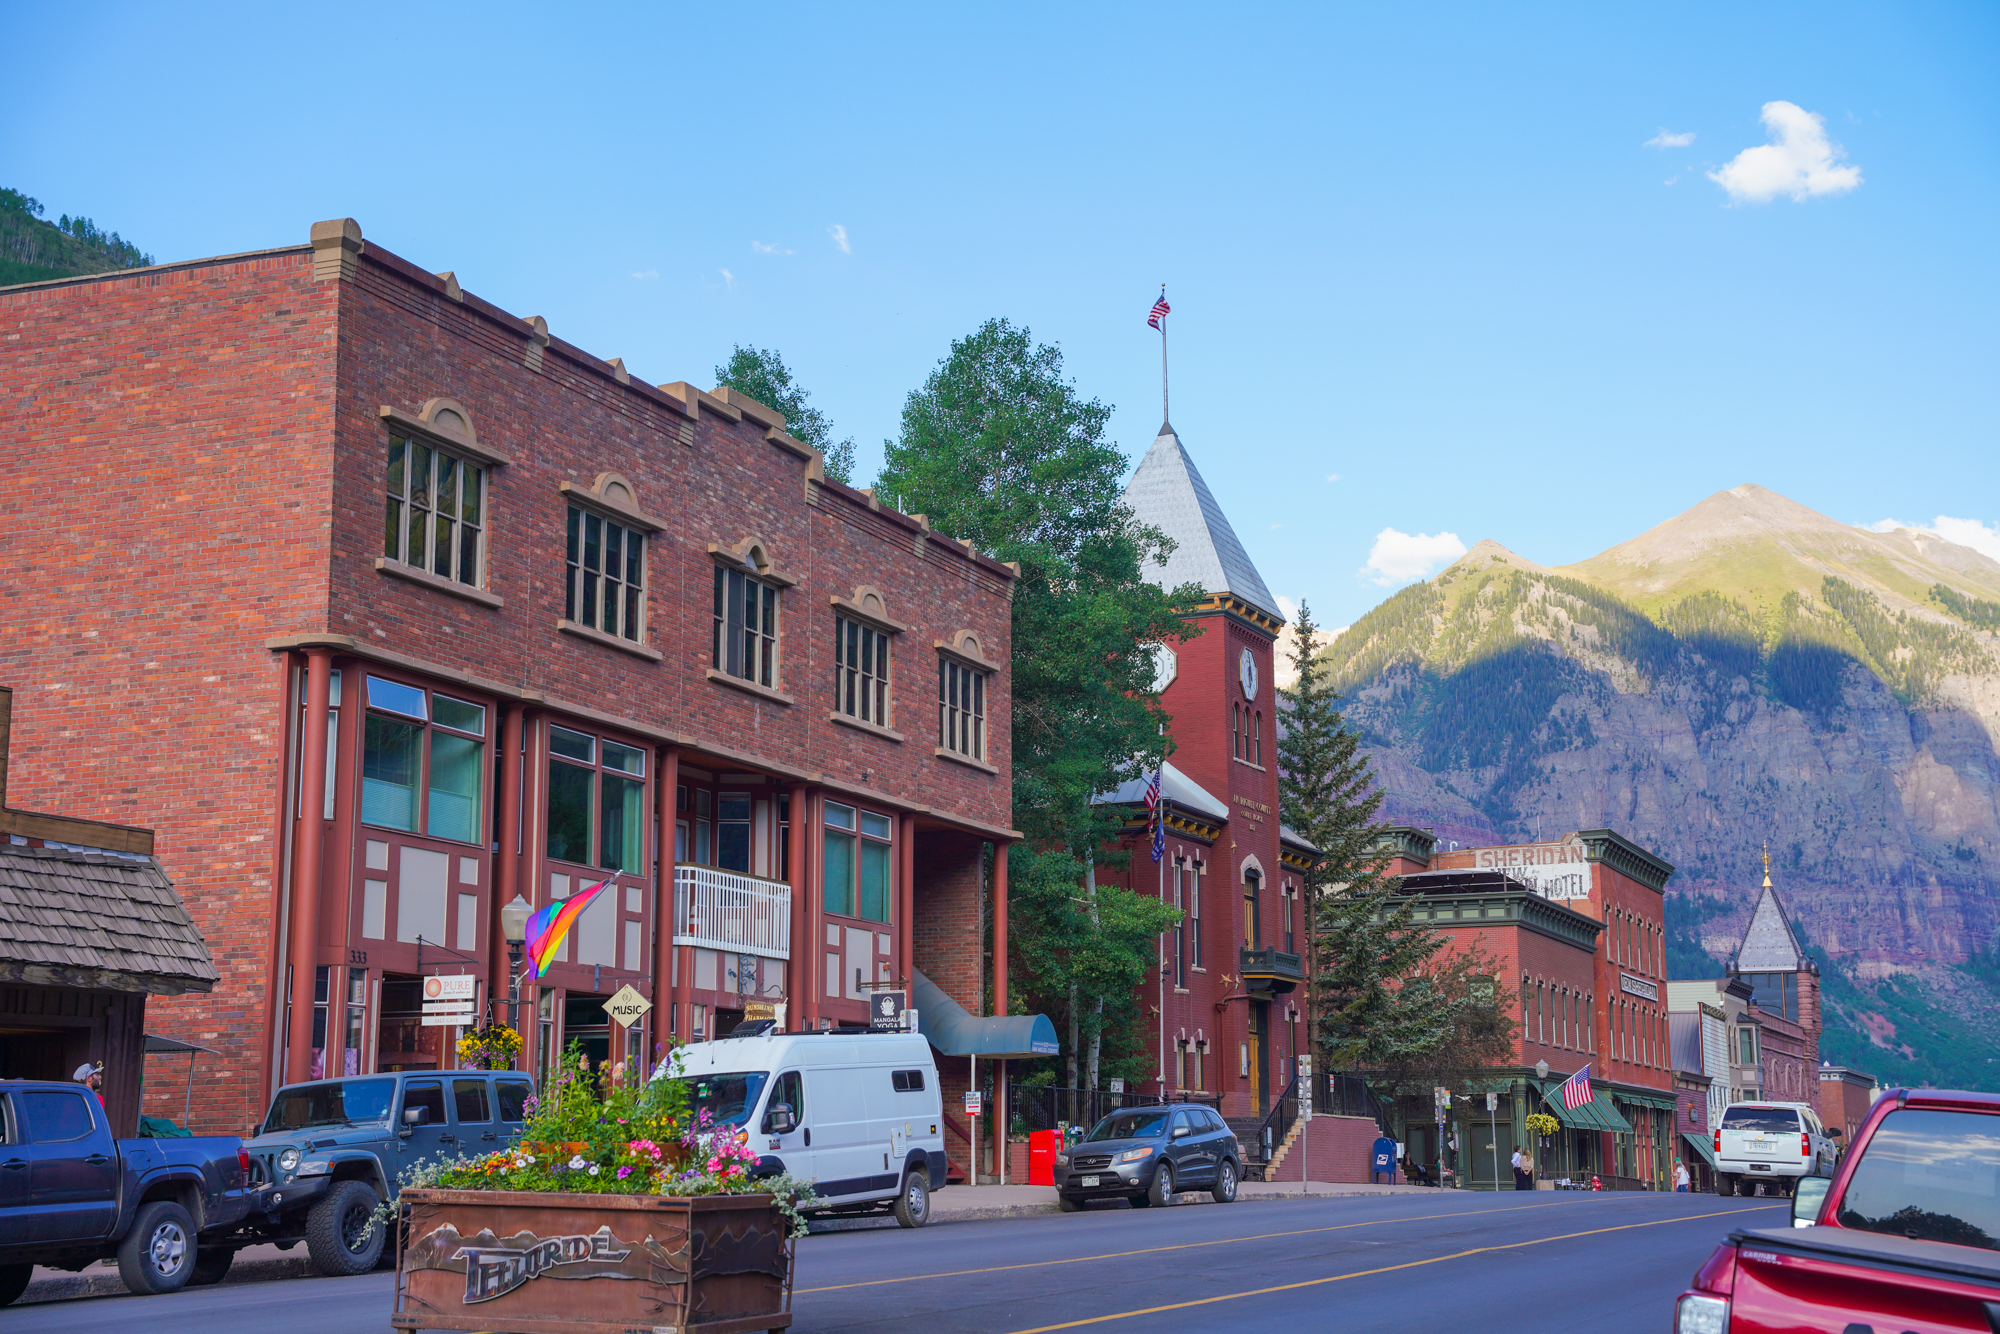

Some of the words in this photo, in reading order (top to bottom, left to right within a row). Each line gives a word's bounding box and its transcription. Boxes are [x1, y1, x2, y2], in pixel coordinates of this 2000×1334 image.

[1481, 846, 1583, 868] SHERIDAN
[1545, 874, 1587, 898] HOTEL
[350, 950, 367, 965] 333
[443, 981, 471, 991] PURE
[612, 1005, 642, 1015] MUSIC
[746, 1004, 774, 1013] SUNSHINE
[451, 1234, 631, 1304] TELLURIDE
